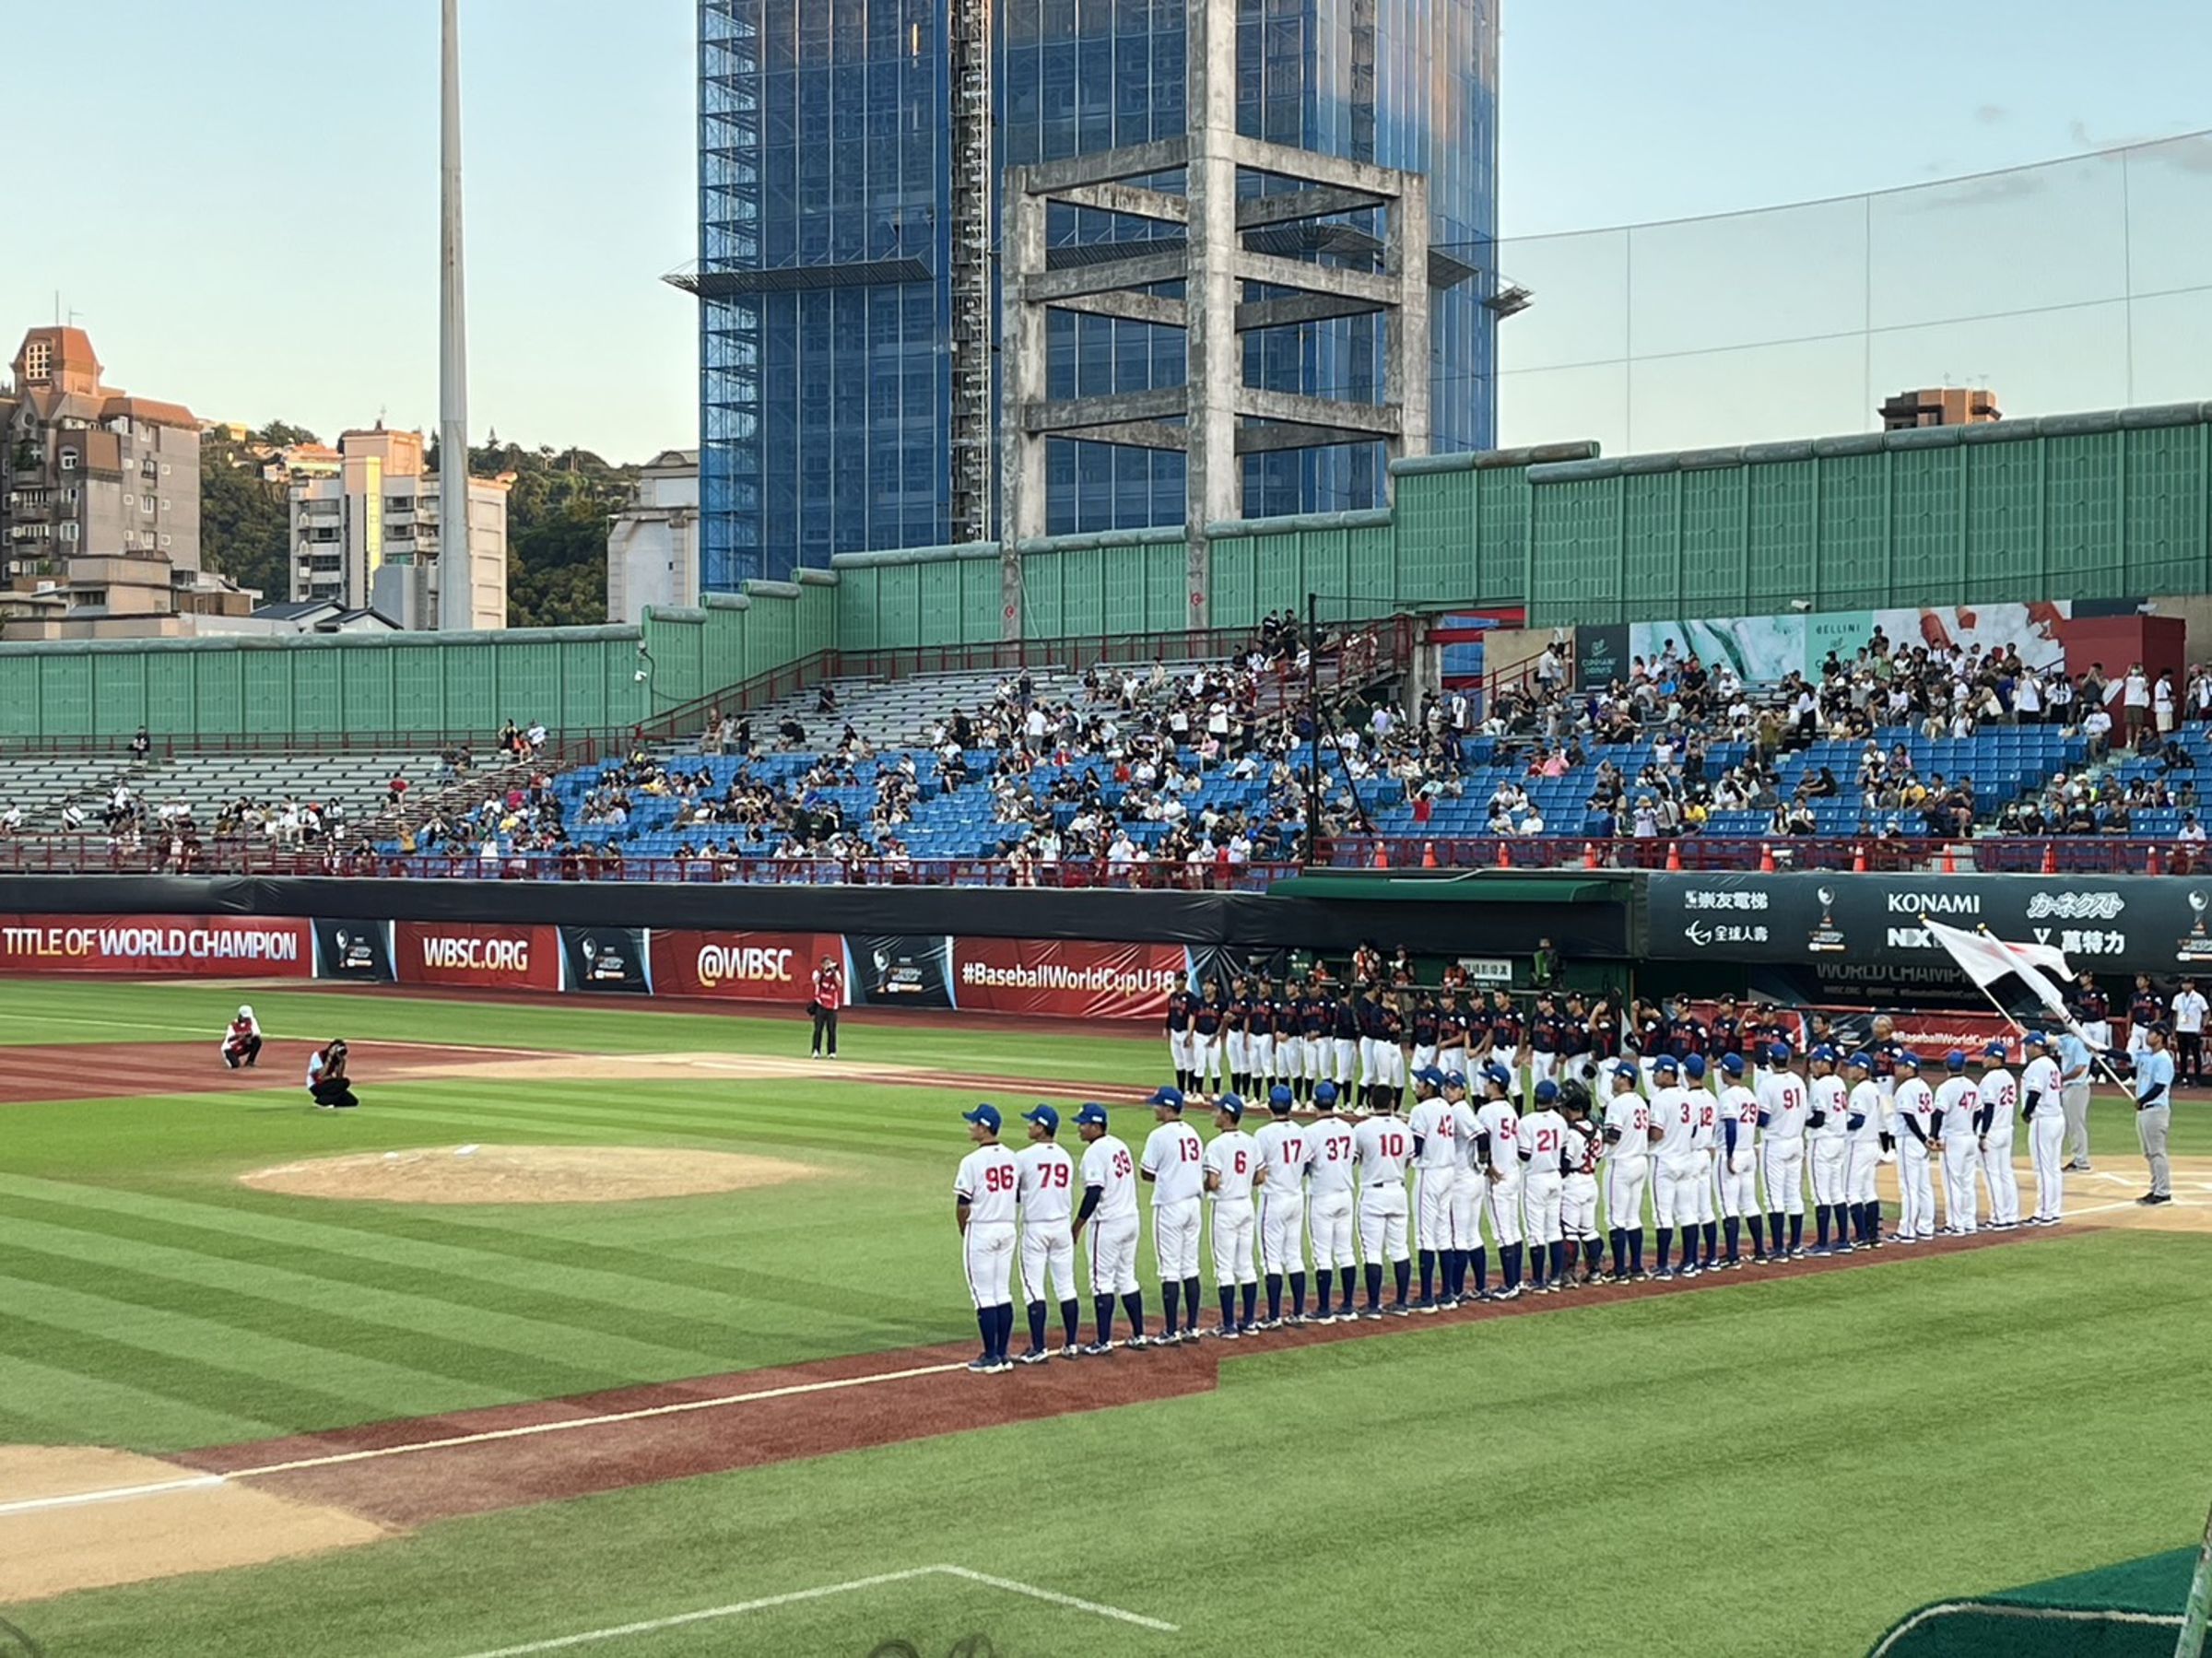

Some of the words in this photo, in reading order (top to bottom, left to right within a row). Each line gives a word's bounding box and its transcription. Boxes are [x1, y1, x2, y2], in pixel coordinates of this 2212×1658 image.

[1888, 893, 1981, 914] KONAMI
[2027, 892, 2124, 919] カーネクスト
[2, 928, 63, 956] TITLE
[65, 928, 97, 956] OF
[99, 929, 185, 958] WORLD
[189, 930, 297, 960] CHAMPION
[423, 937, 528, 971] WBSC.ORG
[698, 945, 794, 988] @WBSC
[962, 962, 1177, 997] #BaseballWorldCupU18
[1783, 1088, 1801, 1110] 91
[1959, 1090, 1977, 1111] 47
[1999, 1085, 2014, 1106] 25
[1680, 1102, 1690, 1123] 3
[1739, 1103, 1758, 1123] 29
[1179, 1137, 1200, 1162] 13
[1282, 1139, 1302, 1164] 17
[1325, 1135, 1351, 1161] 37
[1379, 1134, 1404, 1157] 10
[1536, 1129, 1558, 1152] 21
[1234, 1150, 1247, 1174] 6
[985, 1164, 1015, 1193] 96
[1037, 1162, 1069, 1189] 79
